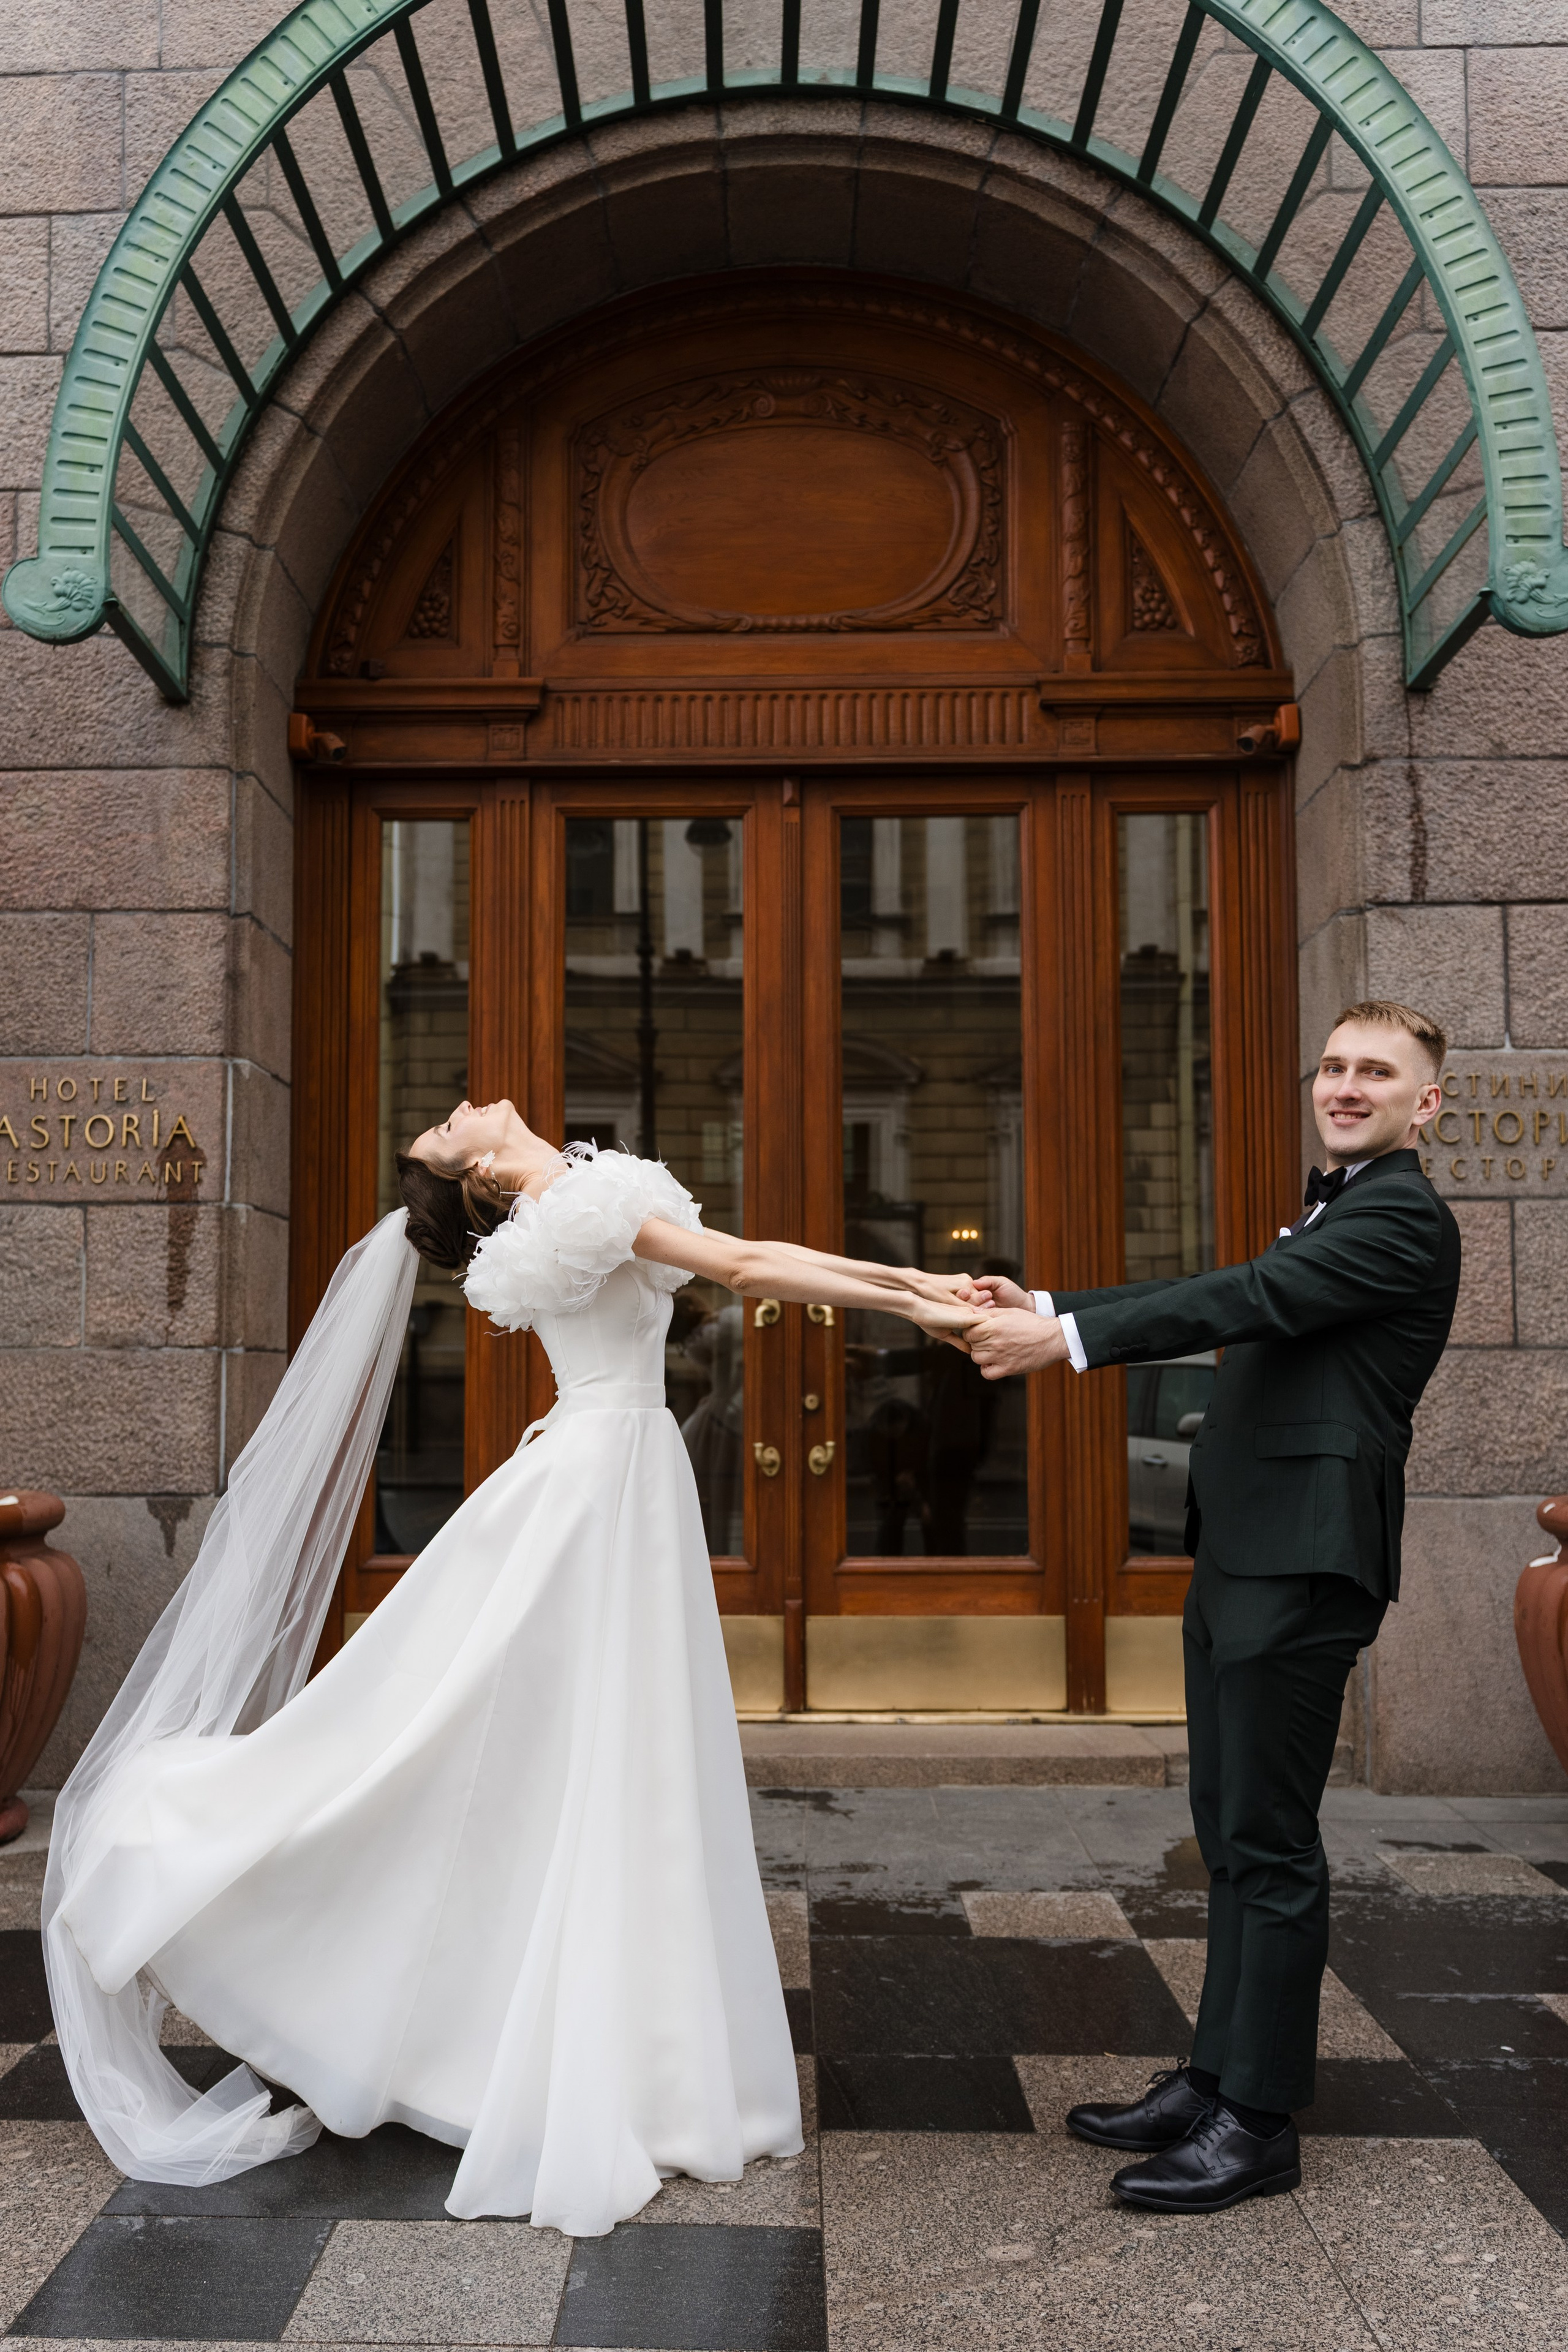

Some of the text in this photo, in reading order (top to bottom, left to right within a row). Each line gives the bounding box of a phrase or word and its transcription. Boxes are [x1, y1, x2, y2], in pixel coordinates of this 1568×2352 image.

[30, 1077, 156, 1102] HOTEL
[1419, 1109, 1568, 1145] СТОР
[7, 1159, 203, 1184] ESTAURANT
[1422, 1157, 1568, 1180] ЕСТОР
